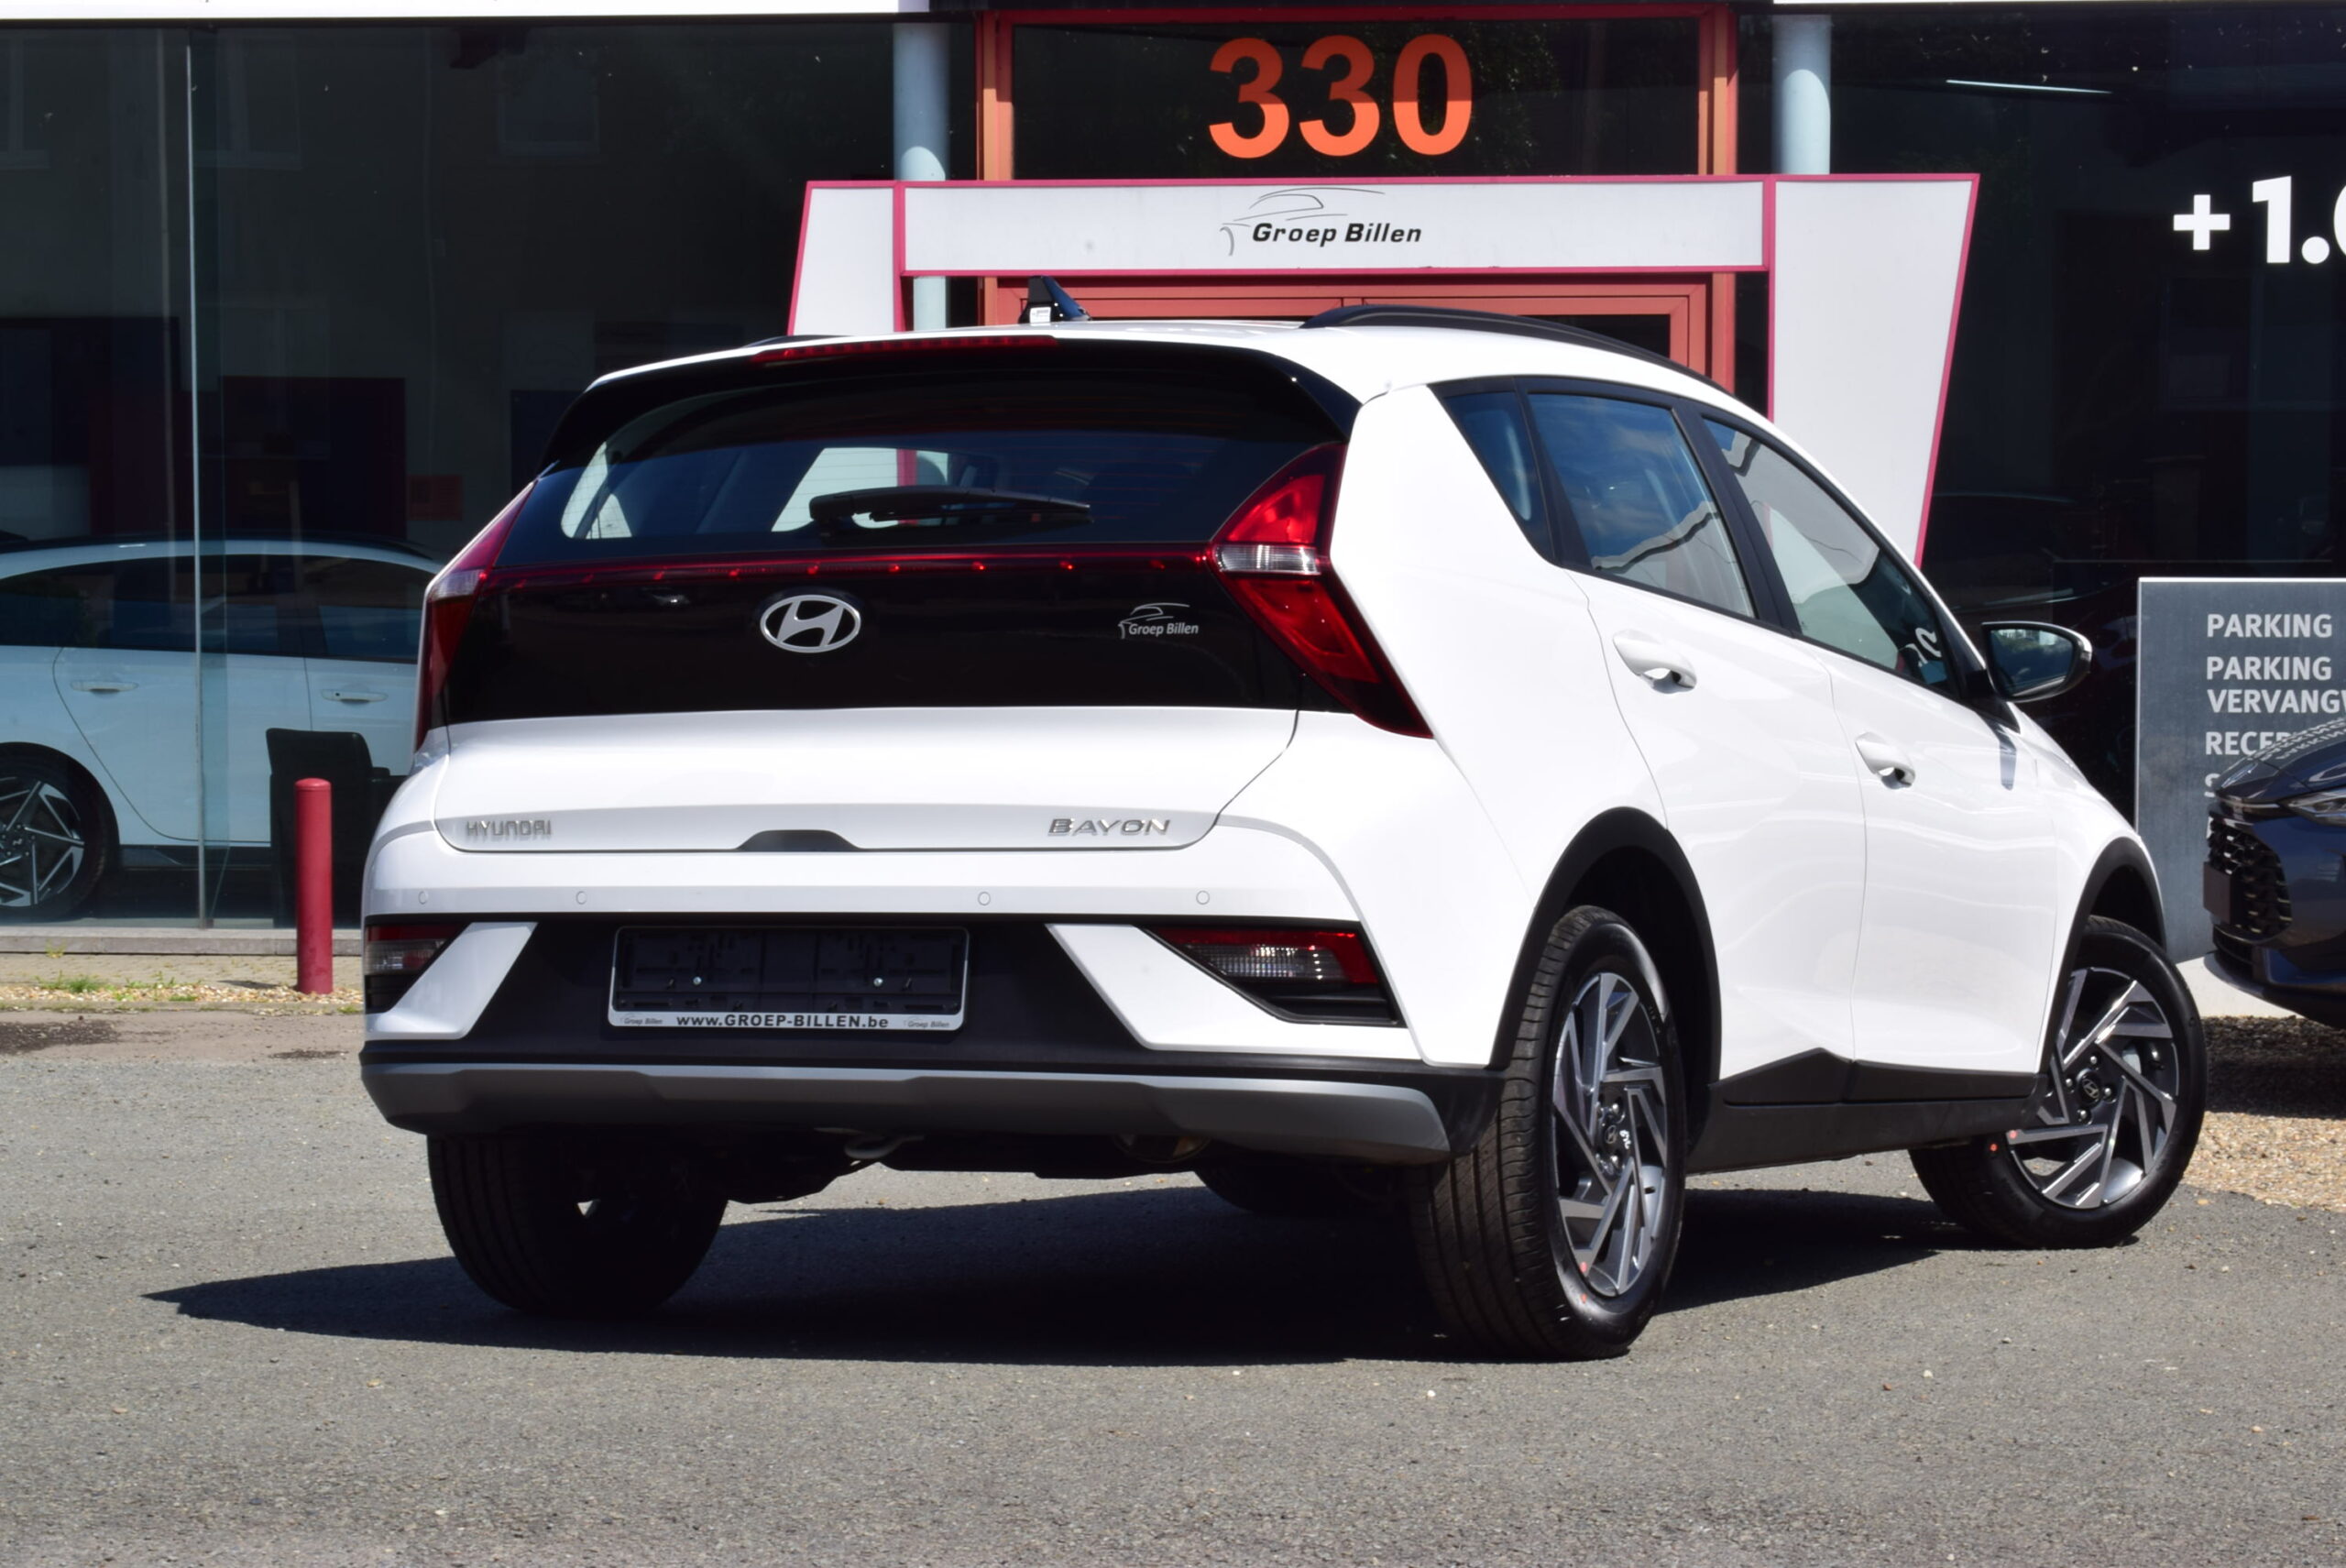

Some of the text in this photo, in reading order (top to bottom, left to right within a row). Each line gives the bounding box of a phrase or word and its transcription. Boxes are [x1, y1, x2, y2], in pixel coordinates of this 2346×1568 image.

[1209, 34, 1472, 159] 330
[1252, 223, 1421, 247] Groep Billen
[1128, 622, 1199, 638] Groep Billen
[2207, 613, 2332, 638] PARKING
[2206, 656, 2332, 681] PARKING
[2205, 731, 2291, 755] RECE
[466, 820, 553, 838] HYUNDAI
[1047, 817, 1170, 836] BAYON
[676, 1014, 889, 1027] www.GROEP-BILLEN.be
